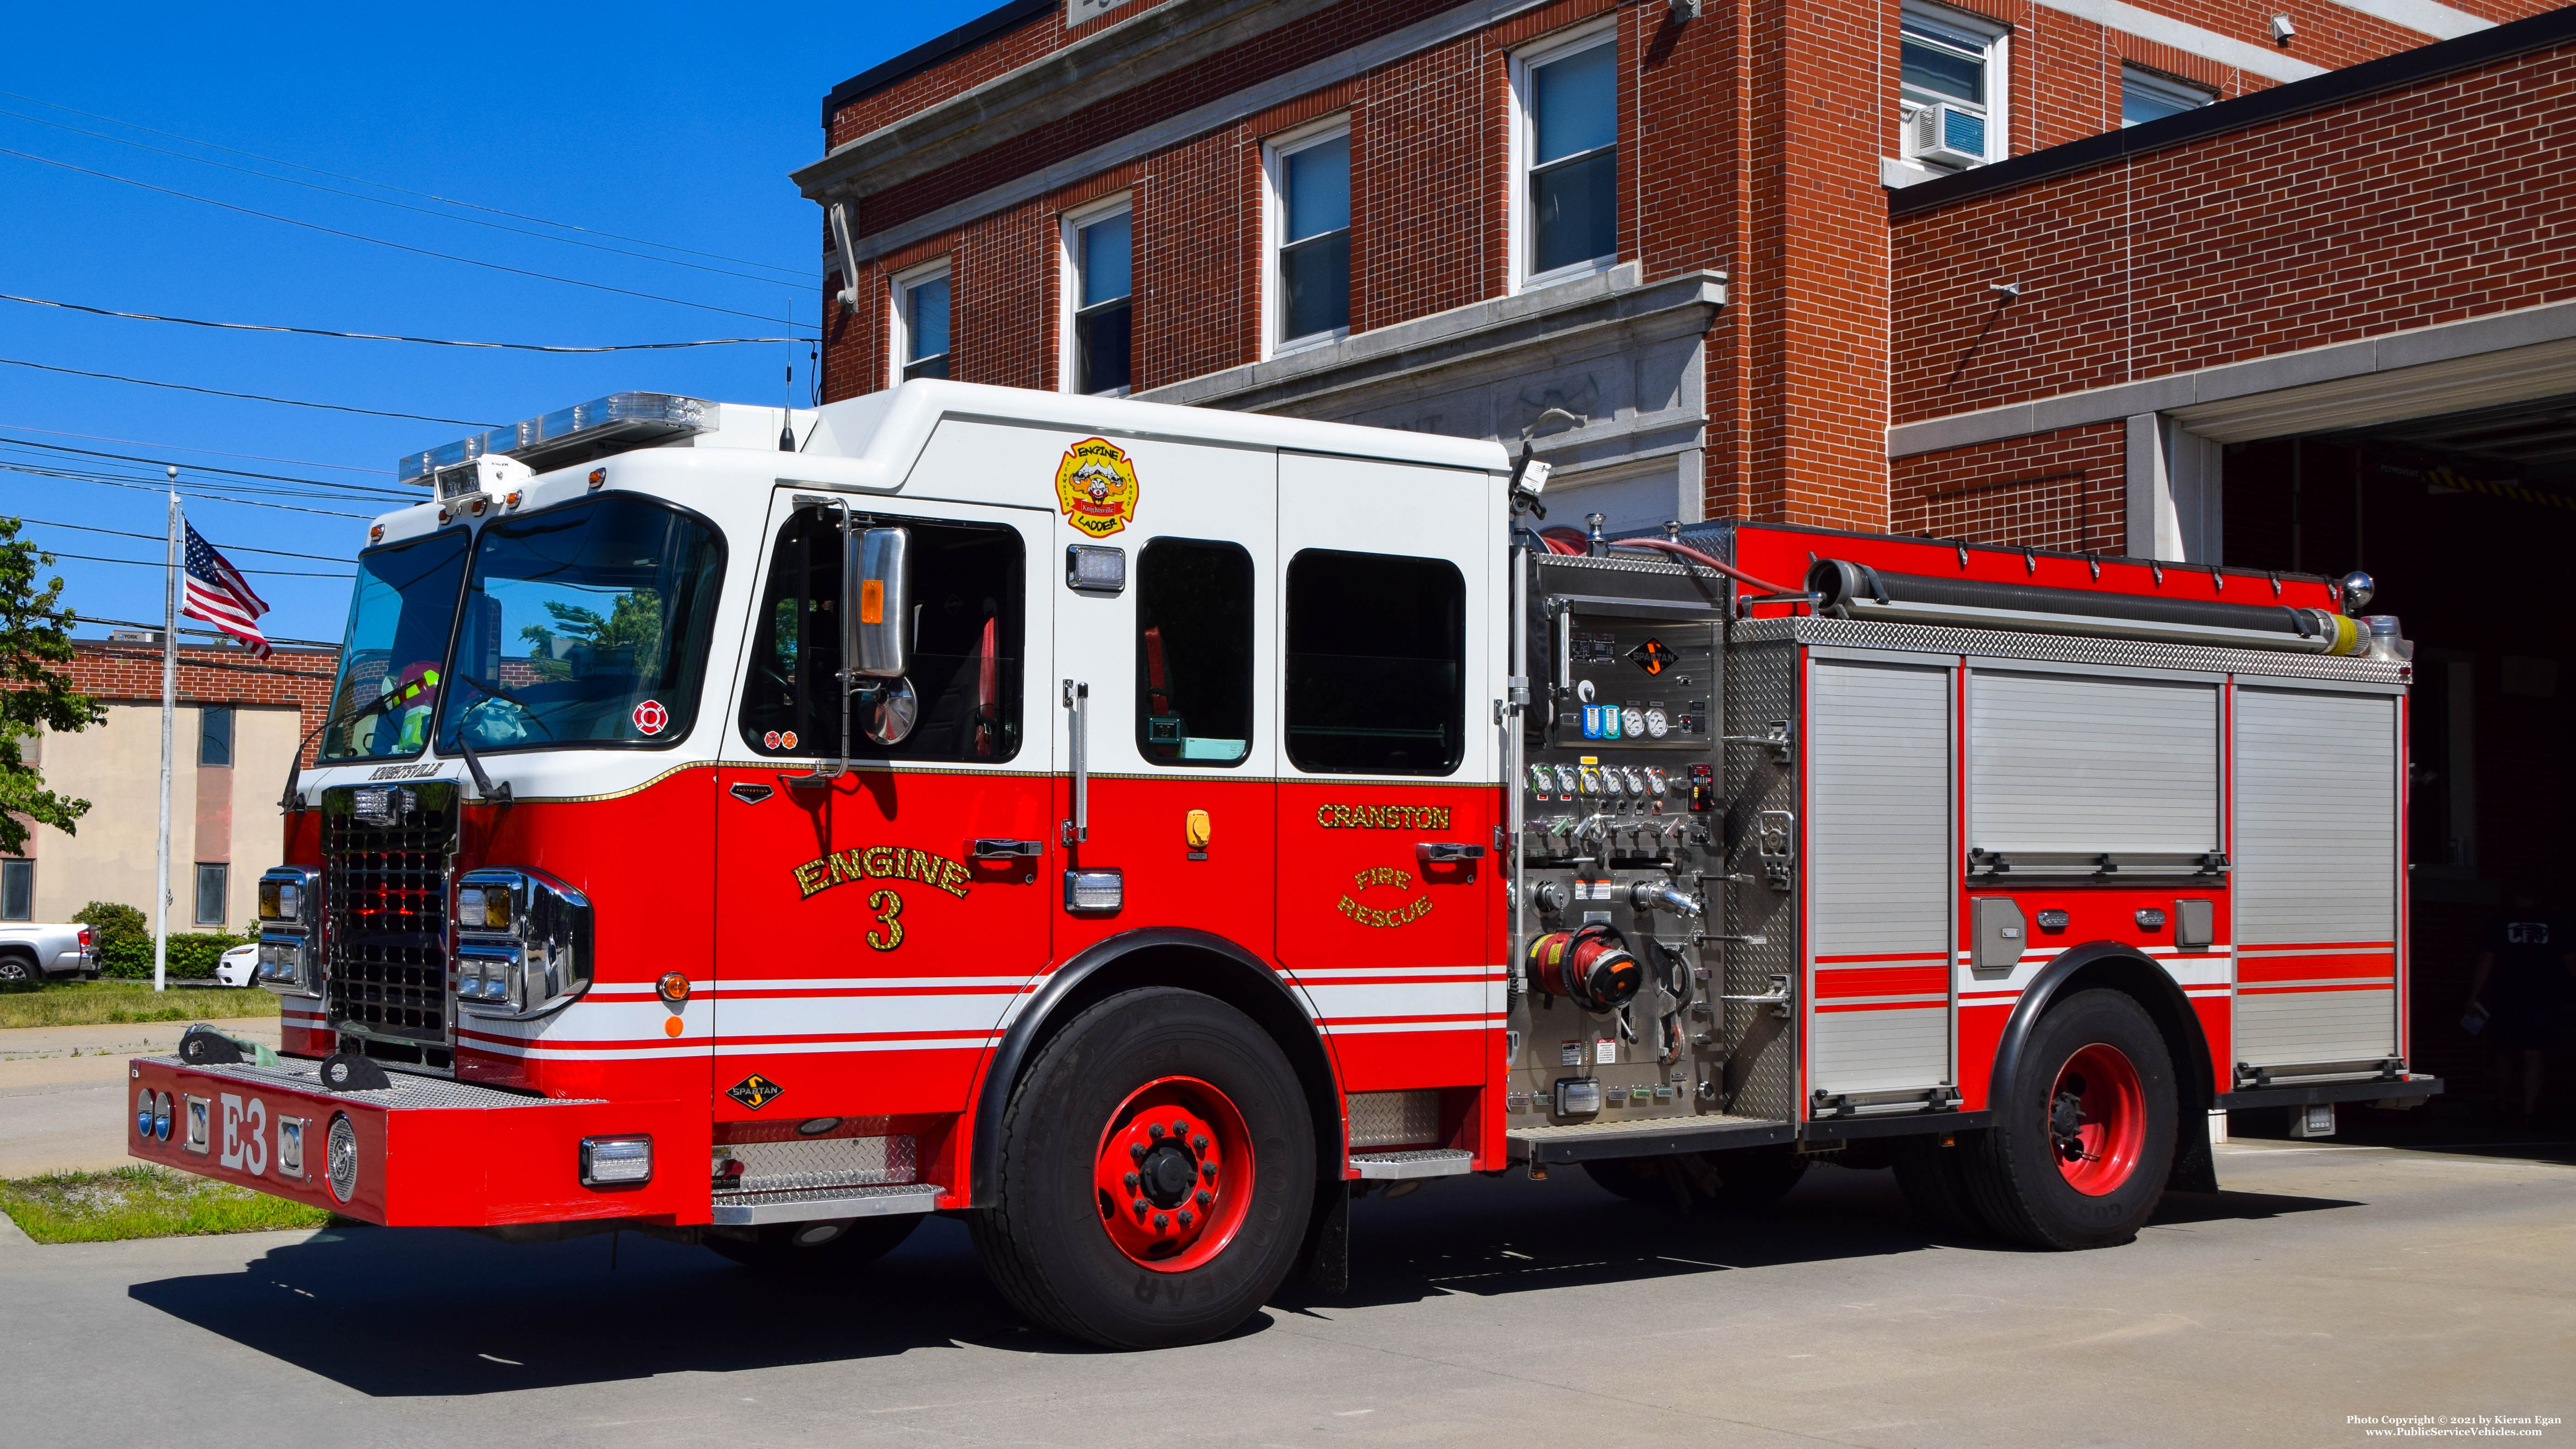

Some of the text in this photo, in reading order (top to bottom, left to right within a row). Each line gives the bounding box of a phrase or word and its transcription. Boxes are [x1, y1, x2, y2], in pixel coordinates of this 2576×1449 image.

[1077, 446, 1119, 461] ENGINE
[1062, 461, 1071, 507] CLOWNING
[1082, 504, 1114, 514] Knightsville
[1077, 515, 1118, 532] LADDER
[1633, 652, 1674, 663] SPARTAN
[368, 762, 445, 780] KNIGHTSVILLE
[1317, 803, 1451, 830] CRANSTON
[792, 846, 973, 900] ENGINE
[1354, 866, 1412, 892] FIRE
[866, 889, 904, 952] 3
[1336, 893, 1433, 928] RESCUE
[733, 1086, 778, 1096] SPARTAN
[221, 1092, 268, 1176] E3
